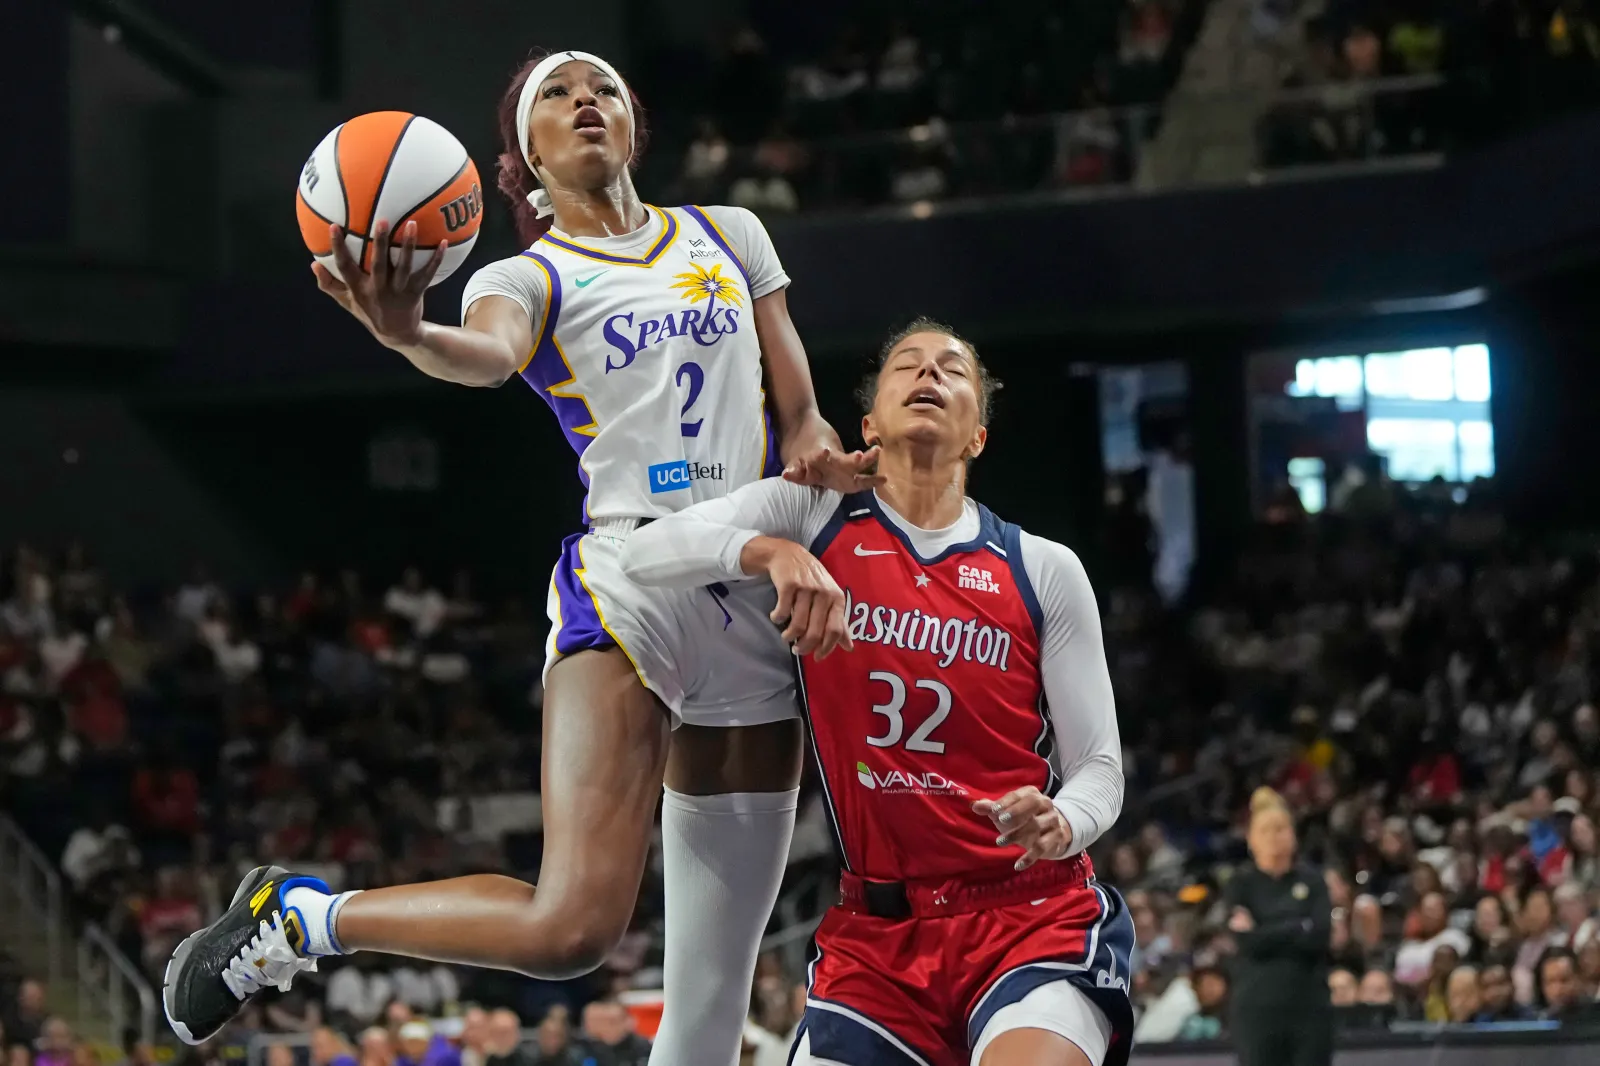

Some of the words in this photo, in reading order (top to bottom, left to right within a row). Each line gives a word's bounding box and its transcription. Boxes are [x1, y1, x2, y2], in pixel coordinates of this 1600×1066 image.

[690, 249, 723, 259] Albert
[603, 307, 739, 374] SPARKS
[675, 361, 705, 438] 2
[958, 564, 993, 582] CAR
[958, 575, 1001, 595] max
[866, 670, 953, 755] 32
